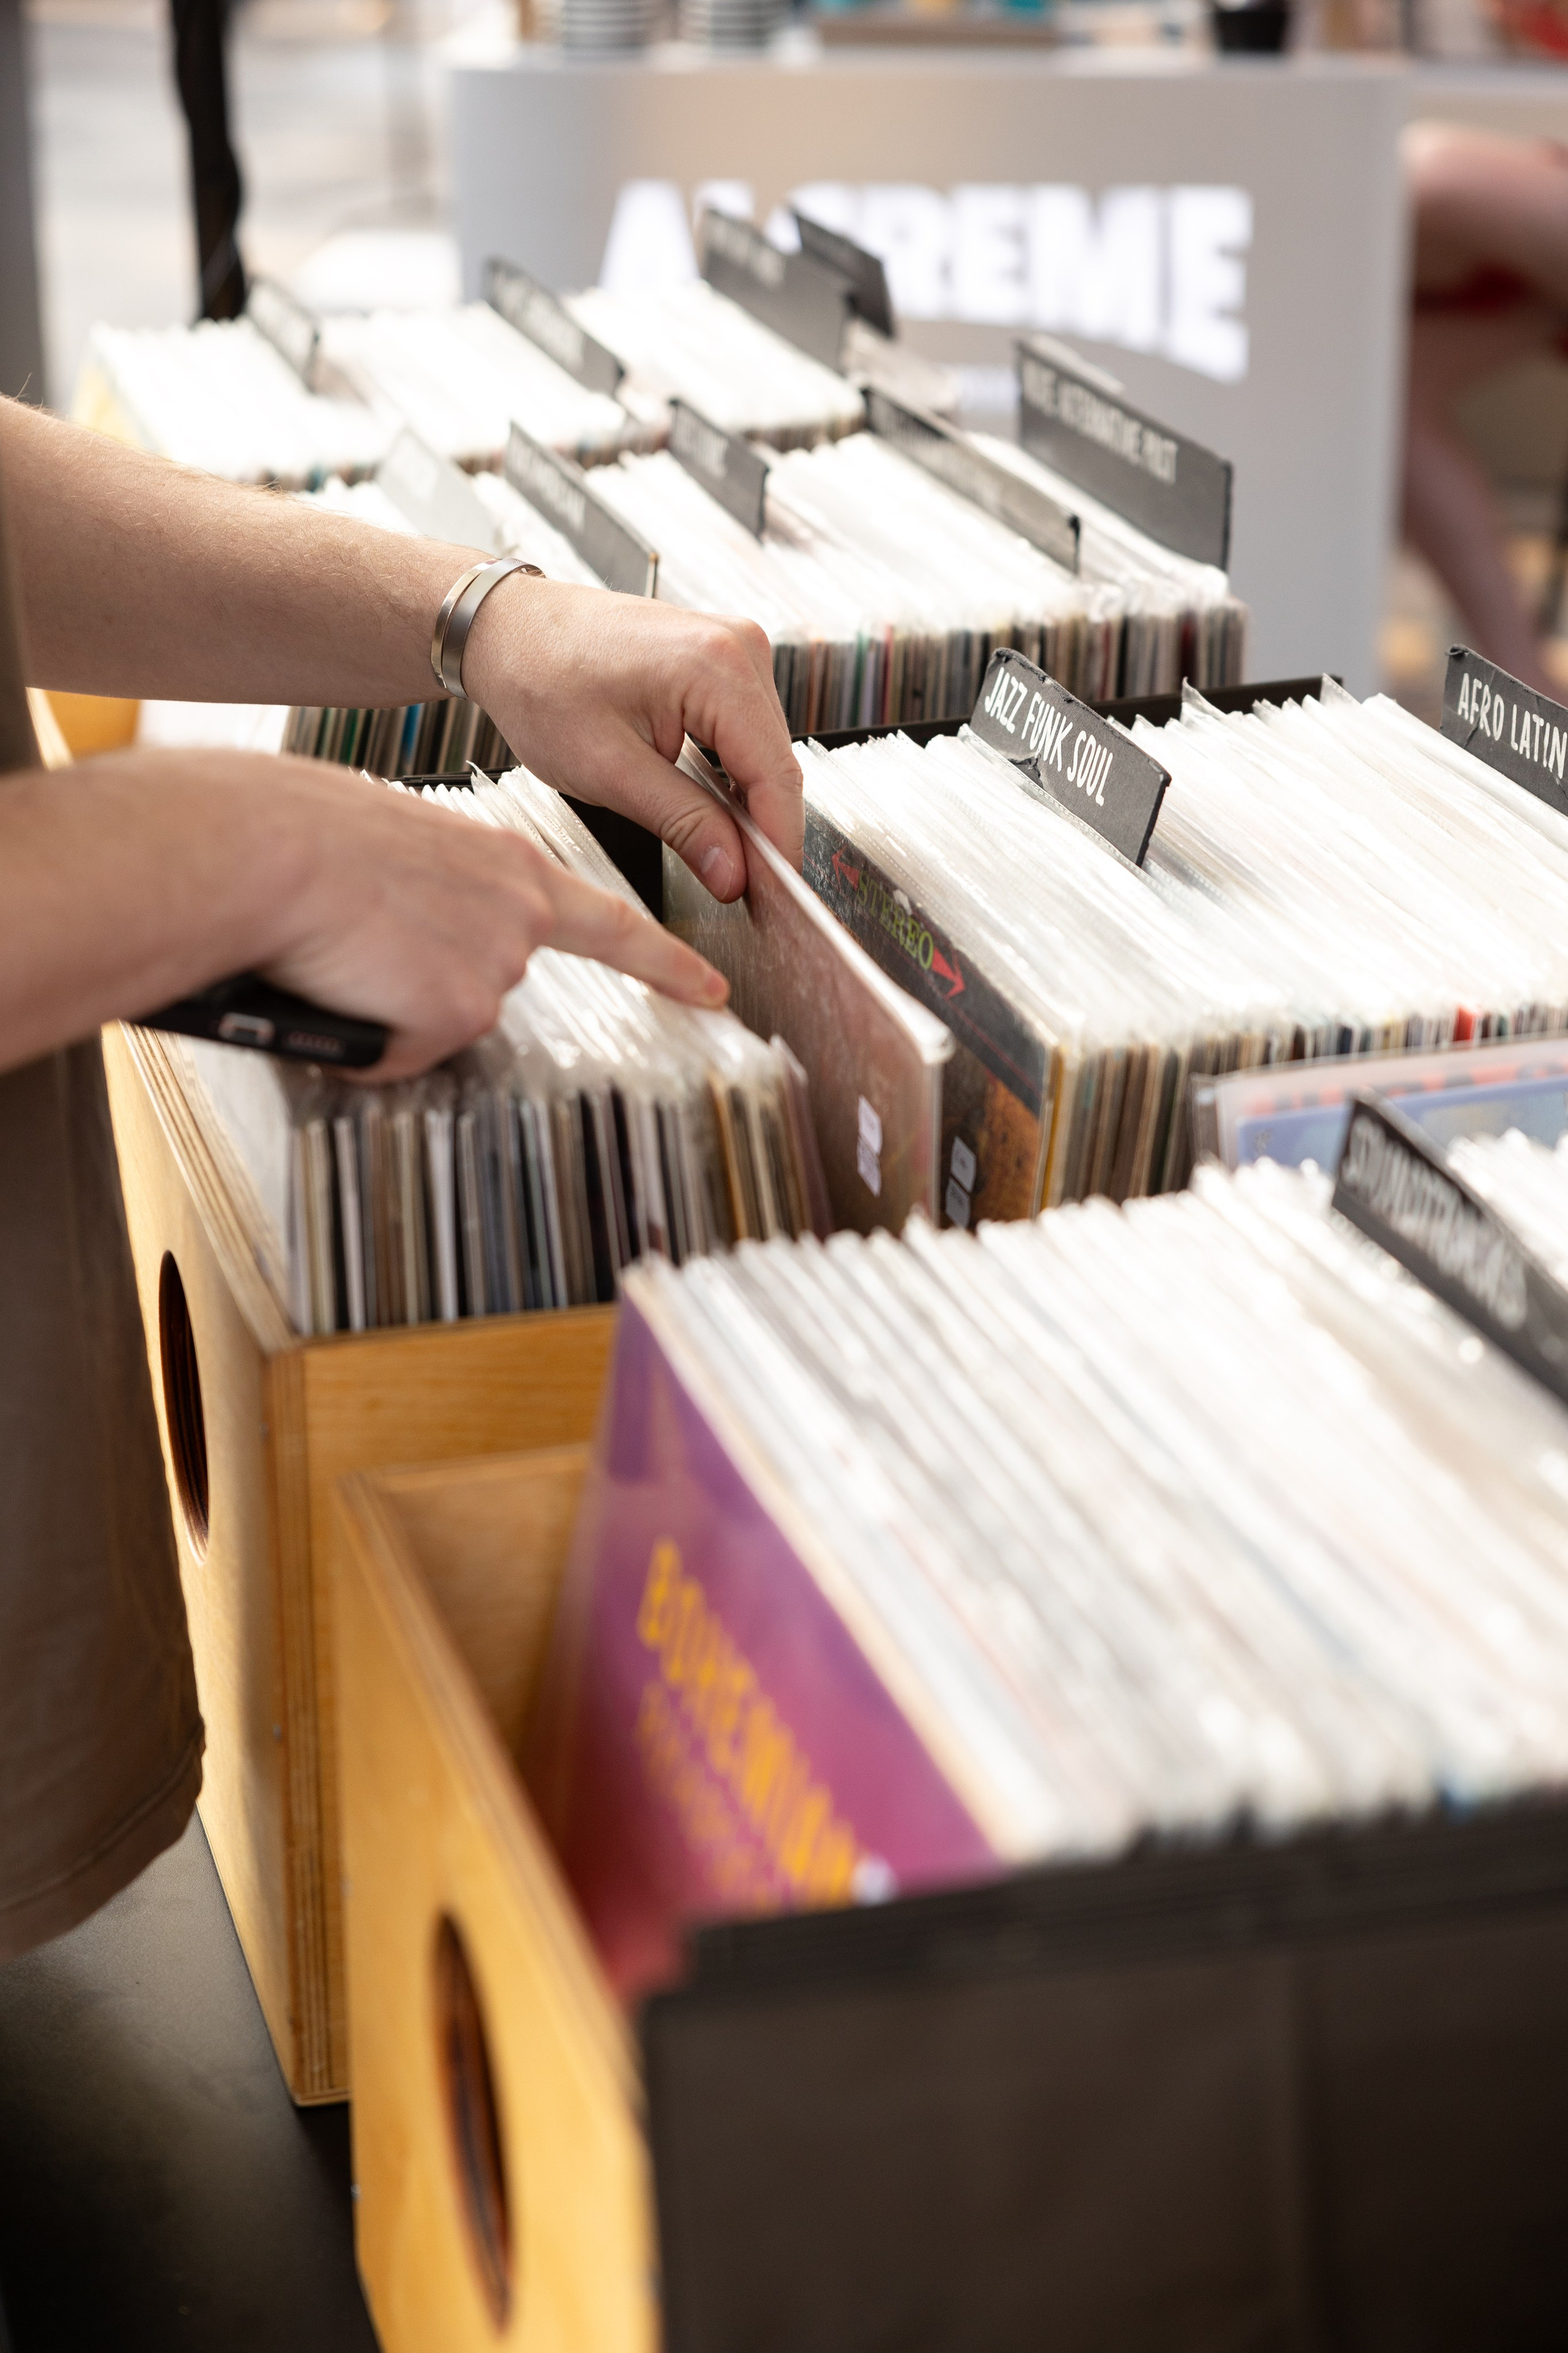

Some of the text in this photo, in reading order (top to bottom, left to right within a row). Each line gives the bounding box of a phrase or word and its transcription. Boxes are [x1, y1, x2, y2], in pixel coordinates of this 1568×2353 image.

[984, 667, 1113, 806] JAZZ FUNK SOUL
[1458, 673, 1567, 779] AFRO LATIN
[858, 870, 933, 969] STEREO
